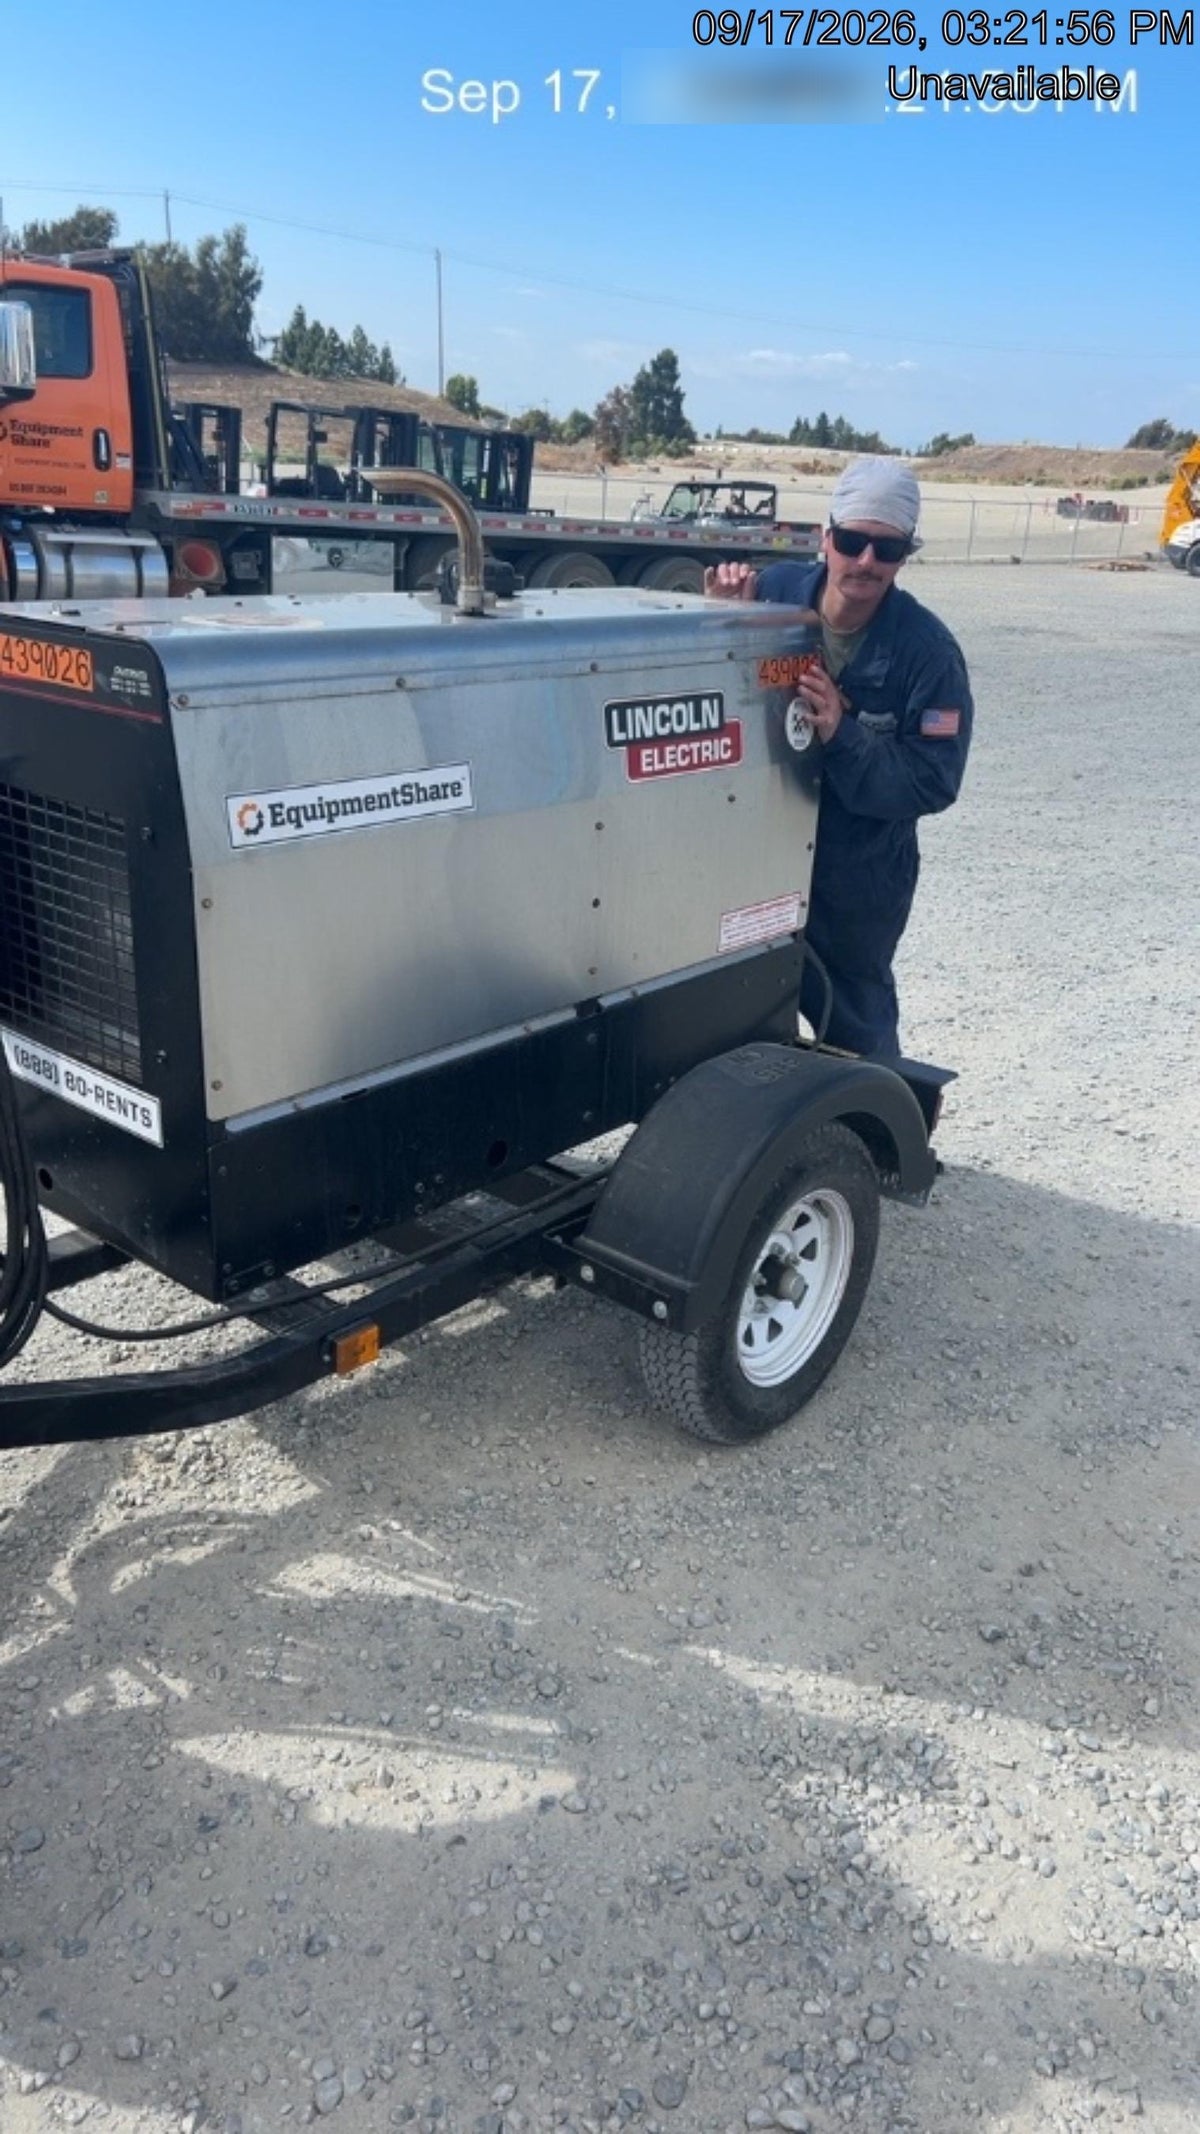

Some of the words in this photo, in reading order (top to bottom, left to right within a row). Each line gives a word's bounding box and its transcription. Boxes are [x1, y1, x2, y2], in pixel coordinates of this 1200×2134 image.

[9, 419, 84, 437] Equipment
[1, 636, 91, 687] 439026
[611, 698, 720, 742] LINCOLN
[641, 737, 732, 773] ELECTRIC
[267, 779, 462, 830] EquipmentShare
[13, 1045, 60, 1085] (888)
[64, 1071, 153, 1129] 80-RENTS
